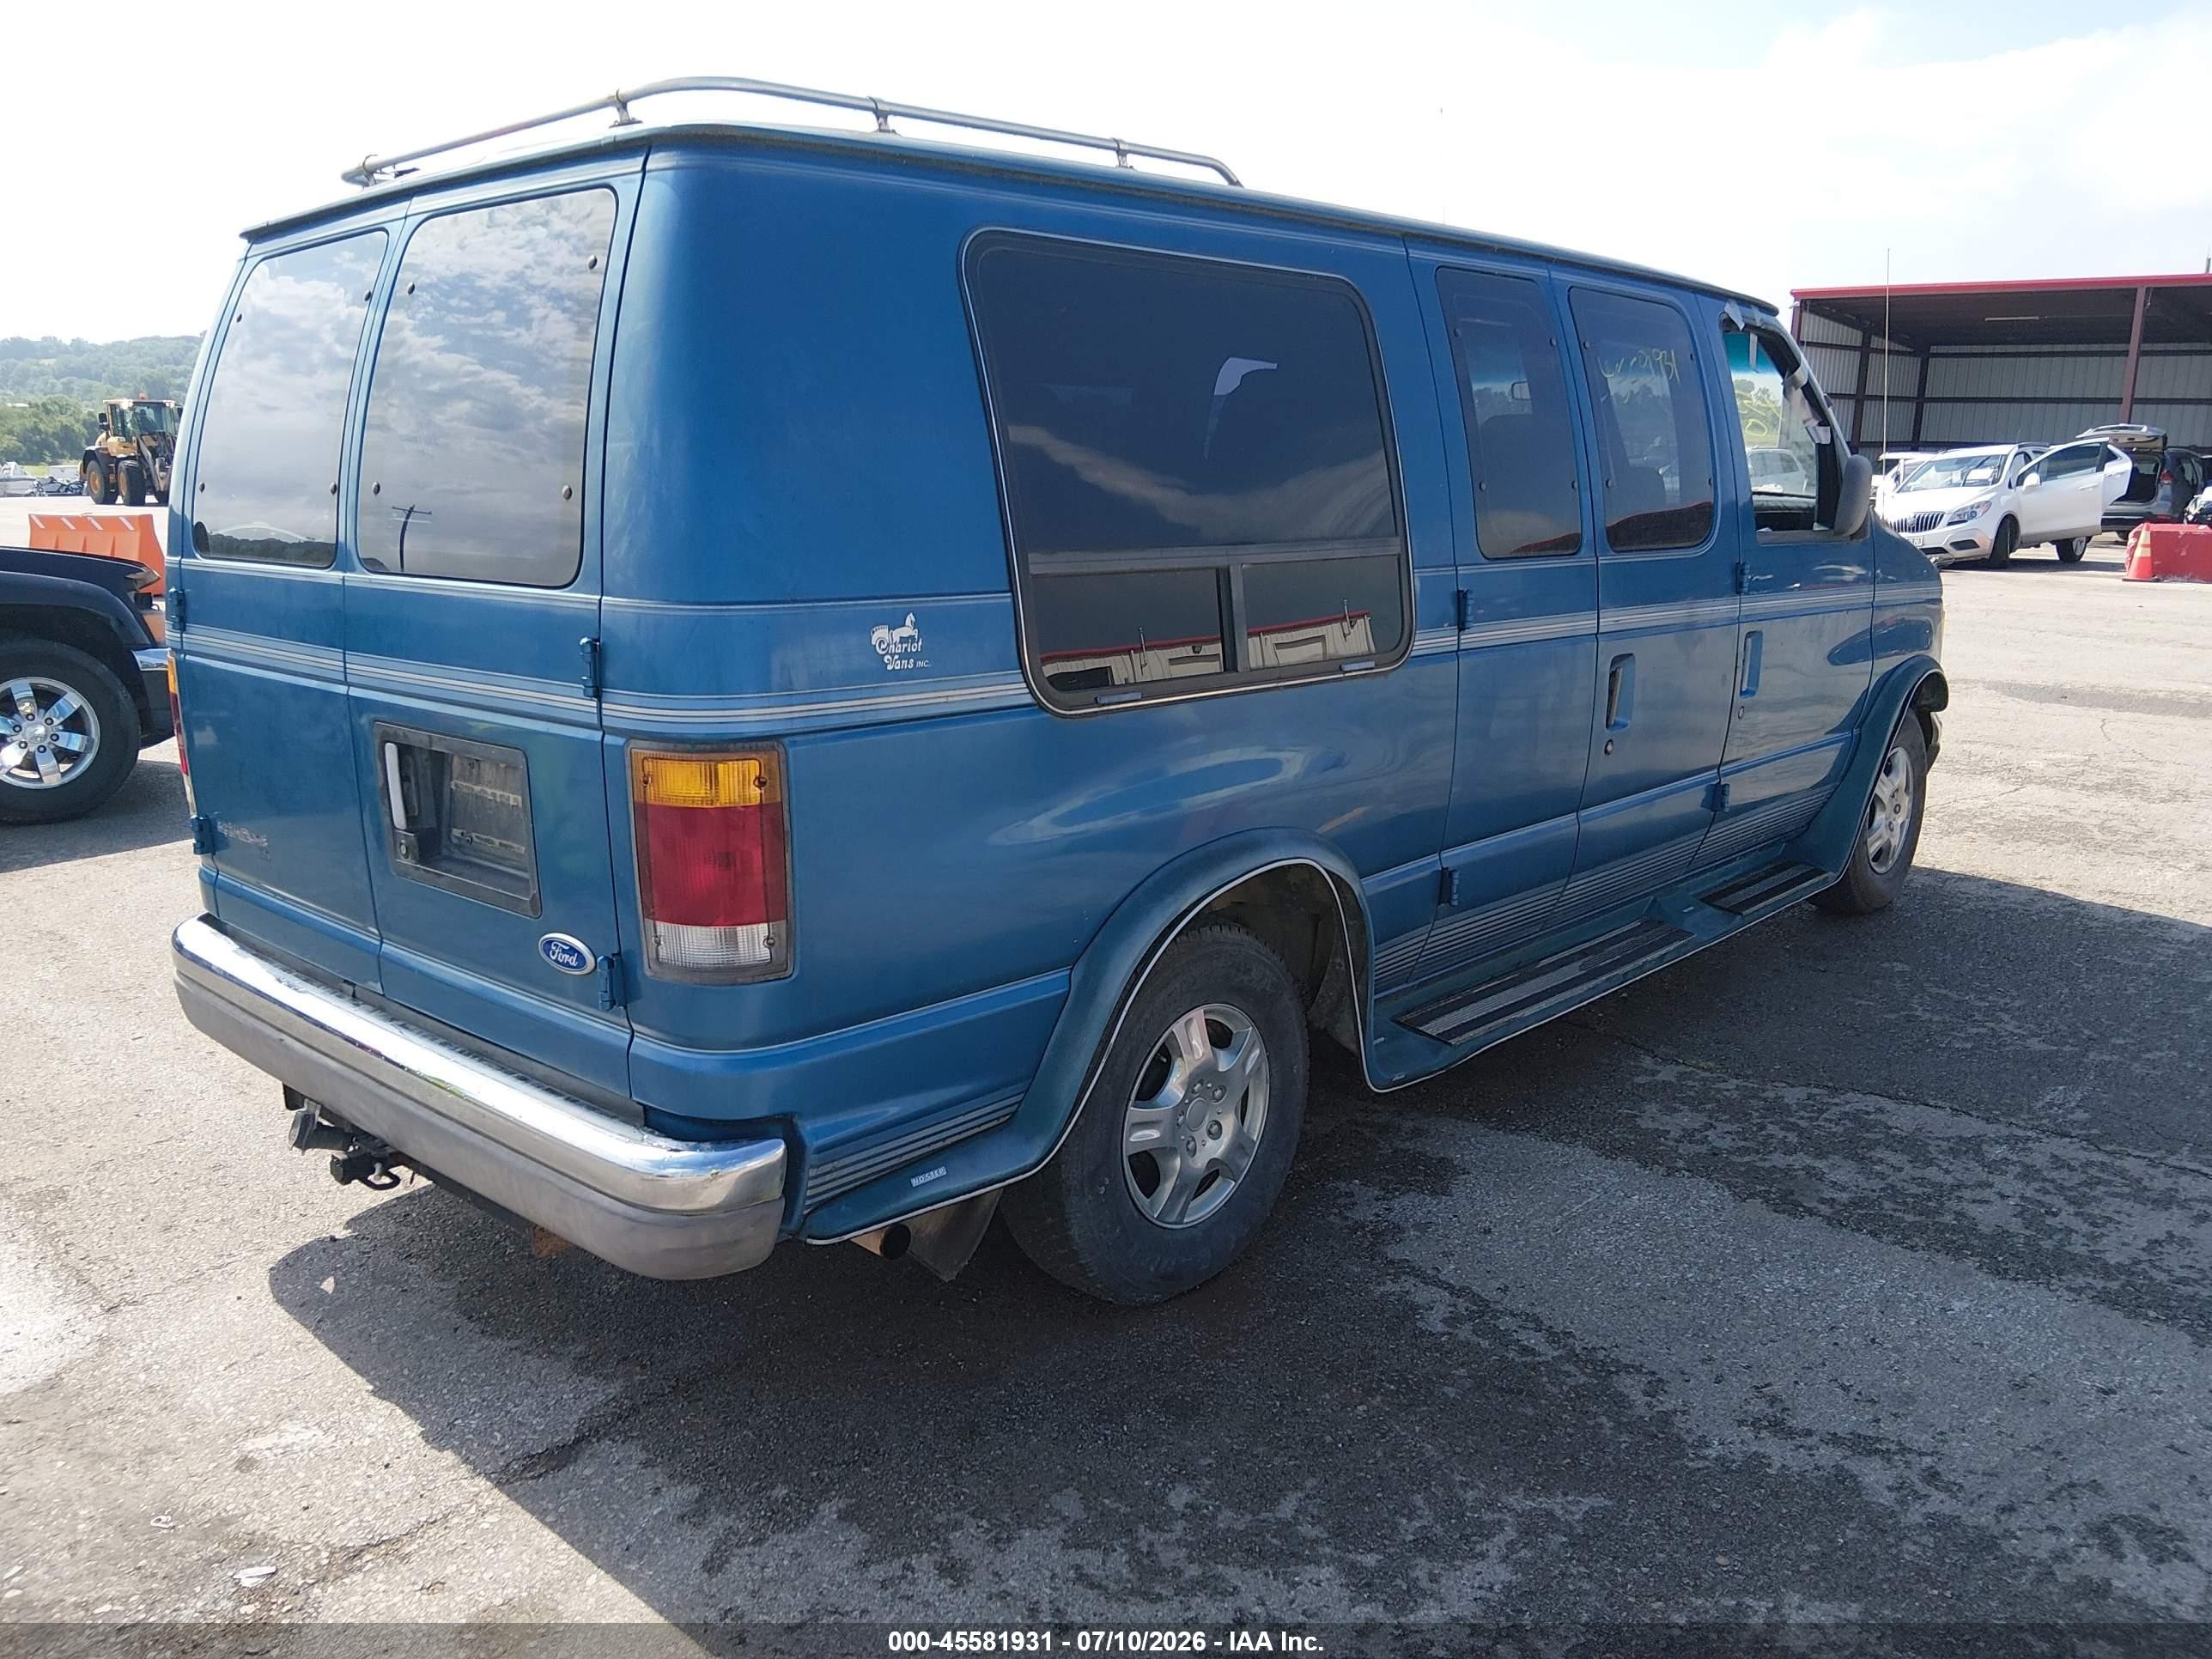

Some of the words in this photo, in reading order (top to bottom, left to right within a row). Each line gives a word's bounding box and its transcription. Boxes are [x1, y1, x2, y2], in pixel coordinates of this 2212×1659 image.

[875, 637, 922, 654] Chariot
[884, 655, 915, 670] Vans
[550, 941, 579, 967] Ford
